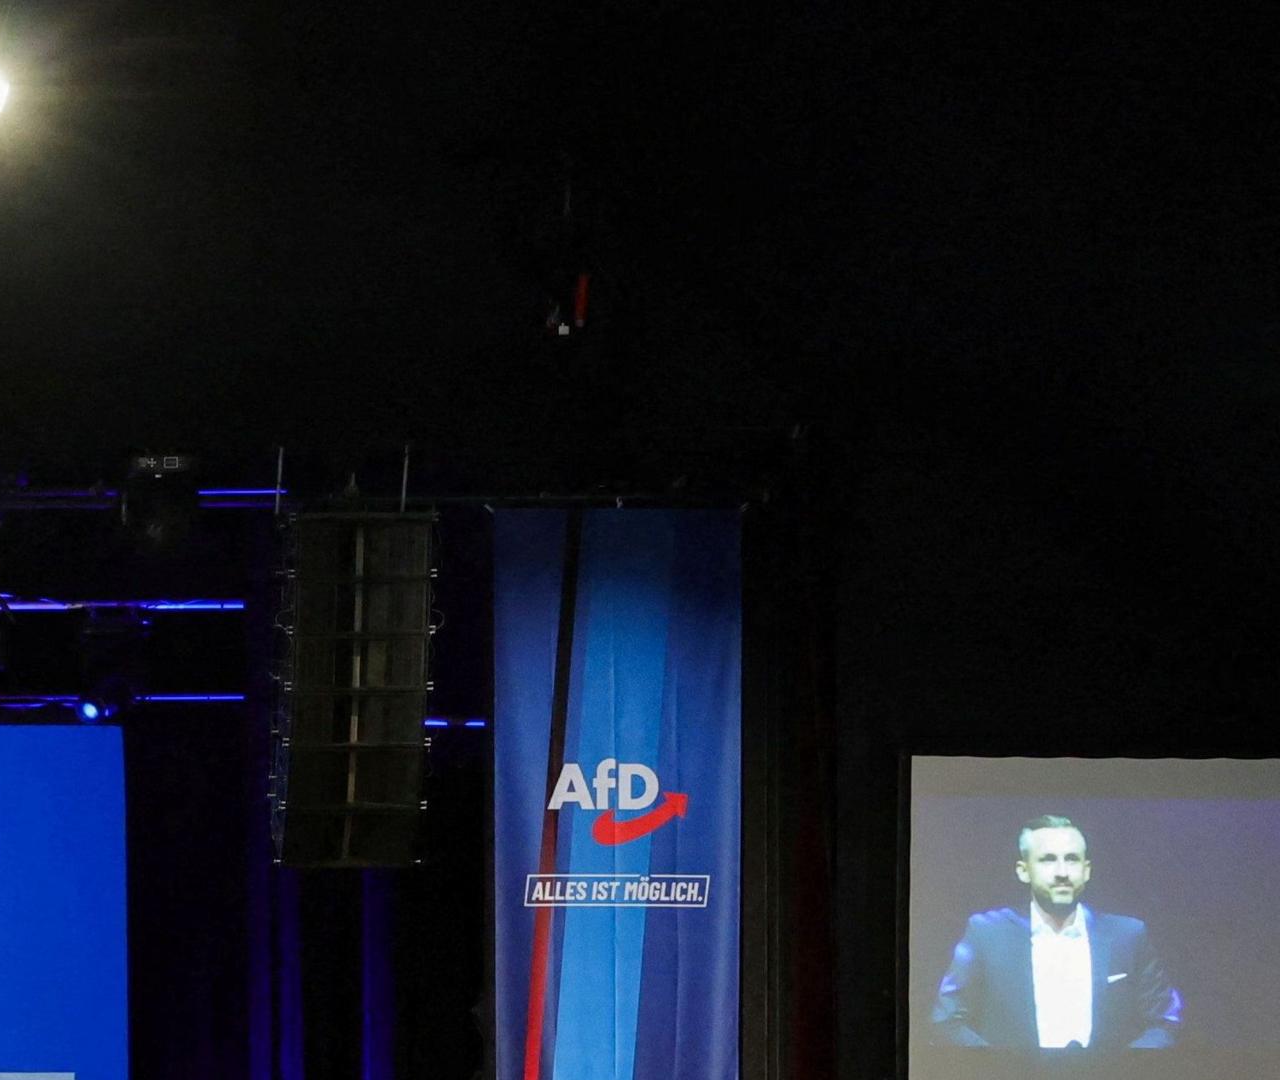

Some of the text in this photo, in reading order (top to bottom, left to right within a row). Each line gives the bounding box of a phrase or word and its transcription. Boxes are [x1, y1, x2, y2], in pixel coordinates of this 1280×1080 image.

[547, 758, 659, 810] AfD
[531, 876, 704, 902] ALLES IST MÖGLICH.
